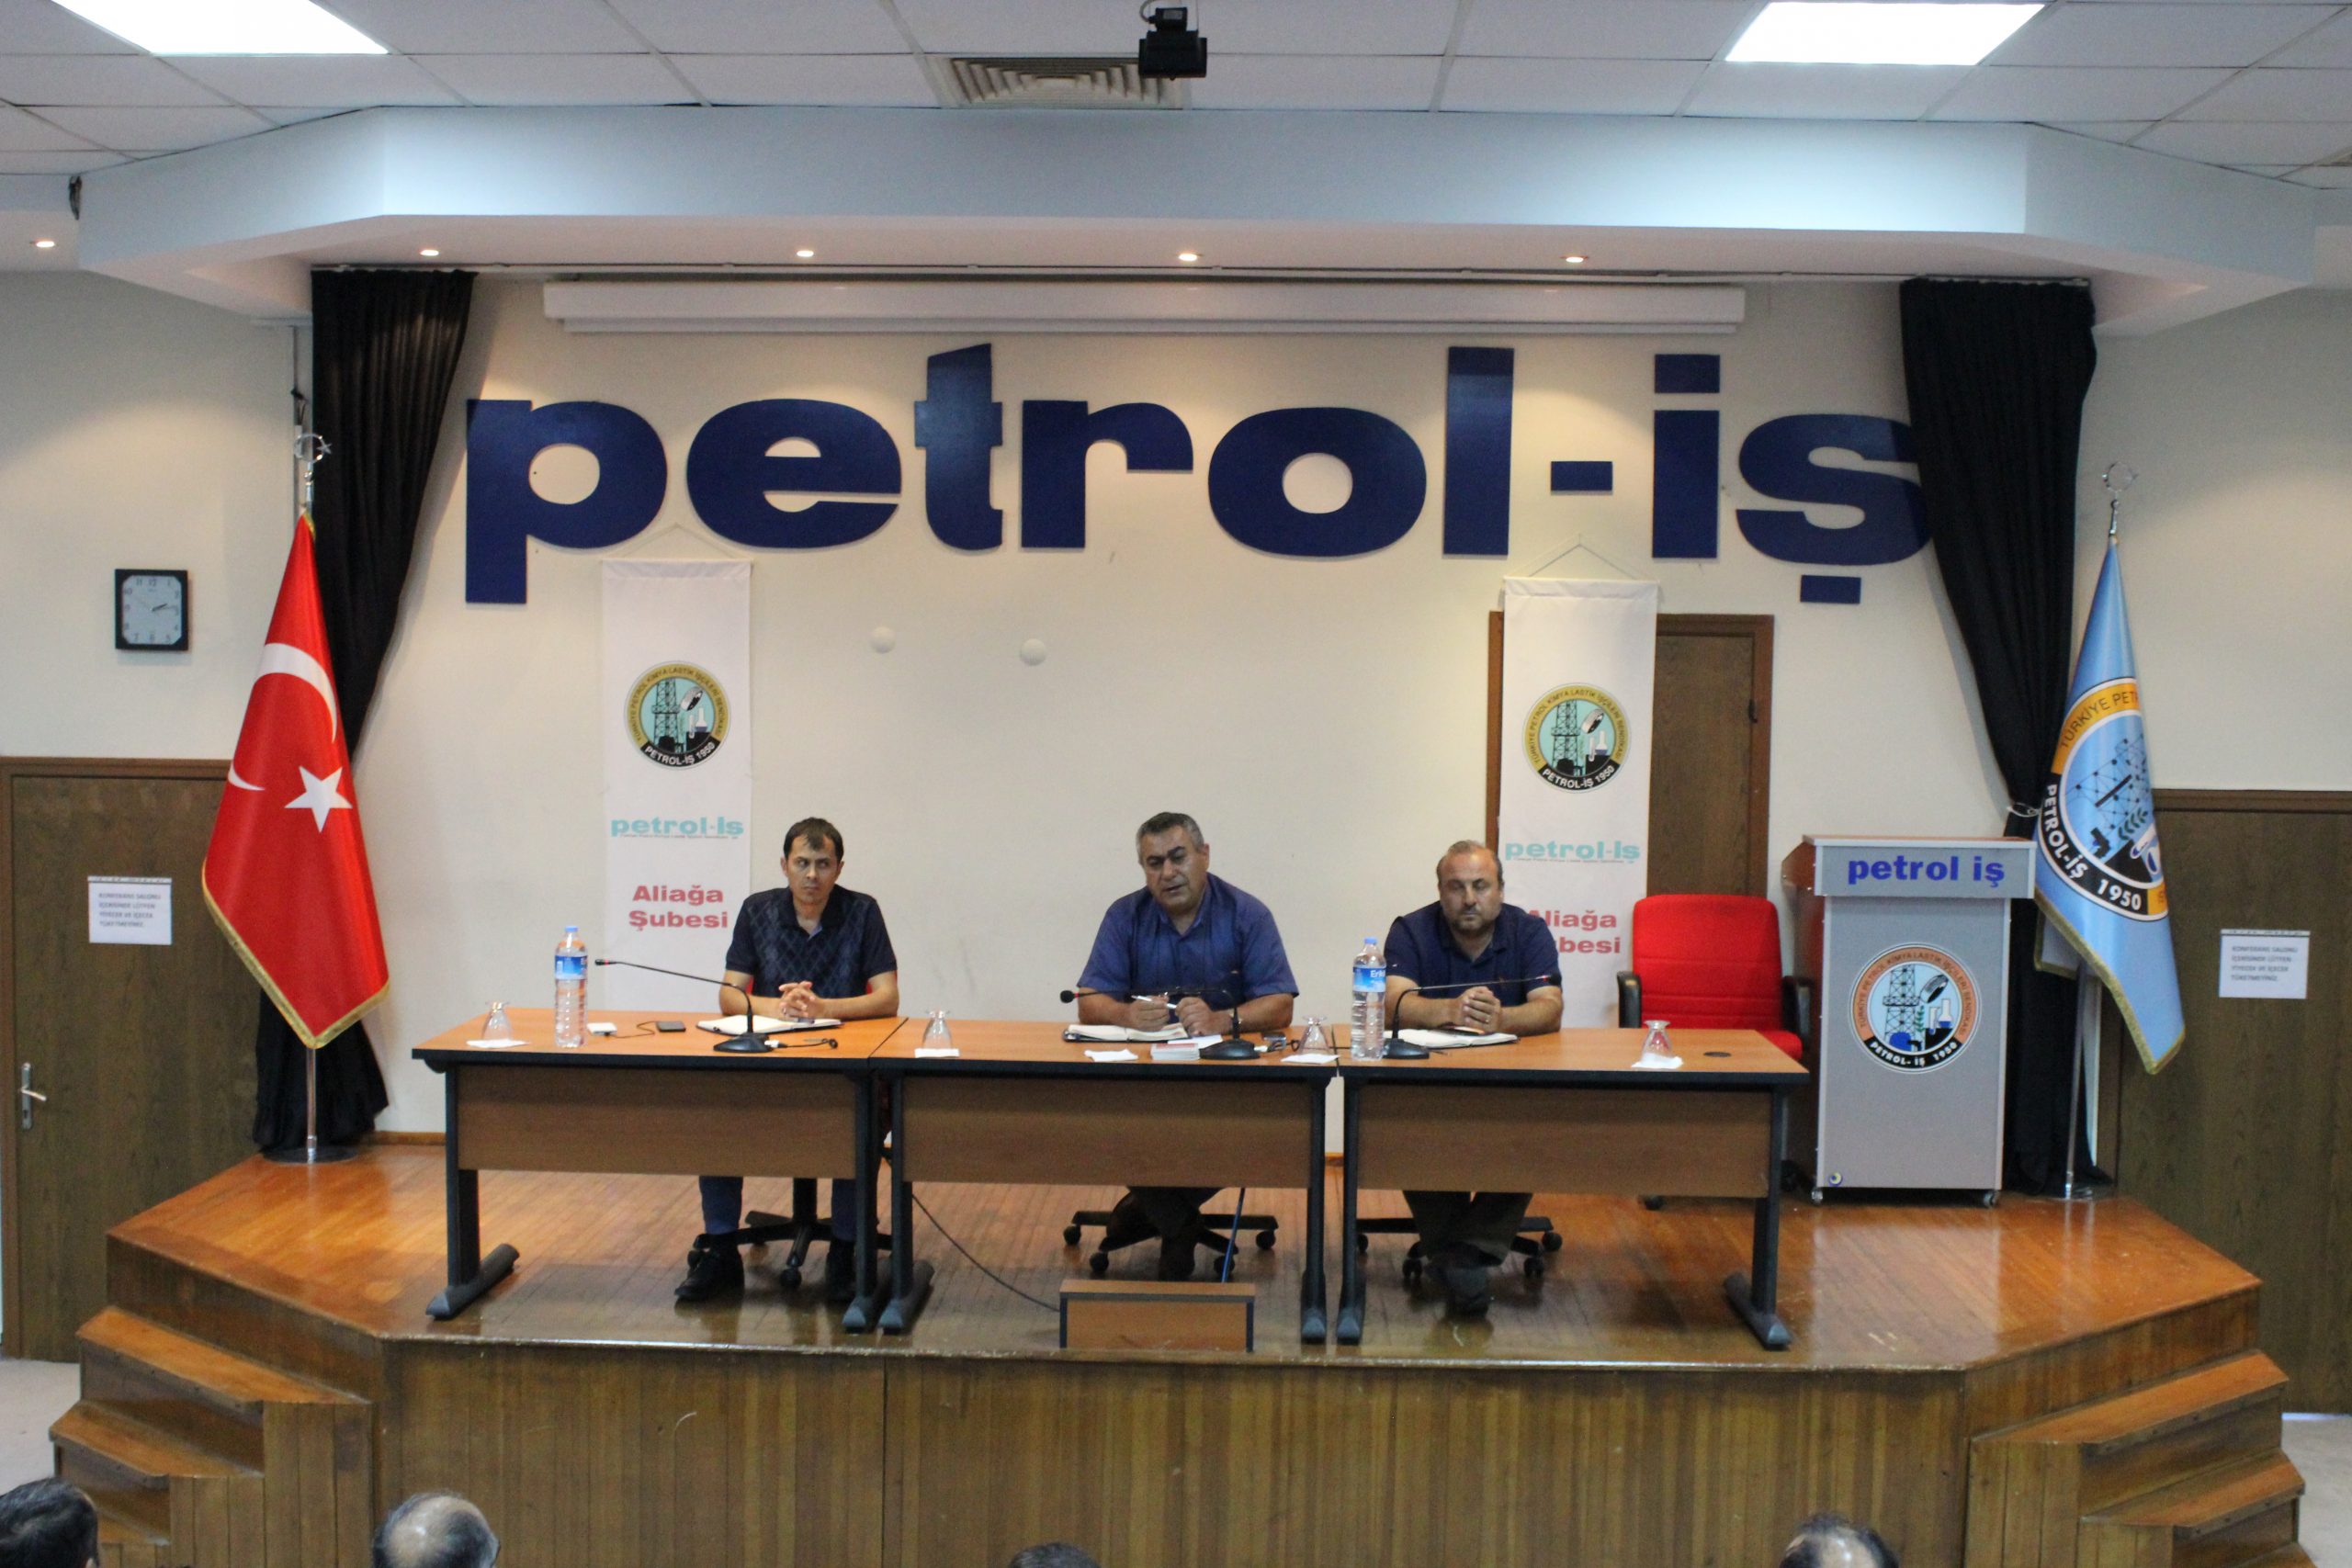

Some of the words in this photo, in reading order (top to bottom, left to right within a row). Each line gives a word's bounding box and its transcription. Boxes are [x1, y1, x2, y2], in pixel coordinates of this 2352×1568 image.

[696, 742, 716, 760] 1950
[1595, 764, 1615, 784] 1950
[2044, 784, 2088, 880] PETROL-İŞ
[2097, 878, 2142, 910] 1950
[1848, 855, 1959, 885] petrol
[1973, 856, 2005, 888] iş
[632, 885, 724, 907] Aliağa
[628, 909, 728, 931] Şubesi
[1557, 937, 1621, 953] besi
